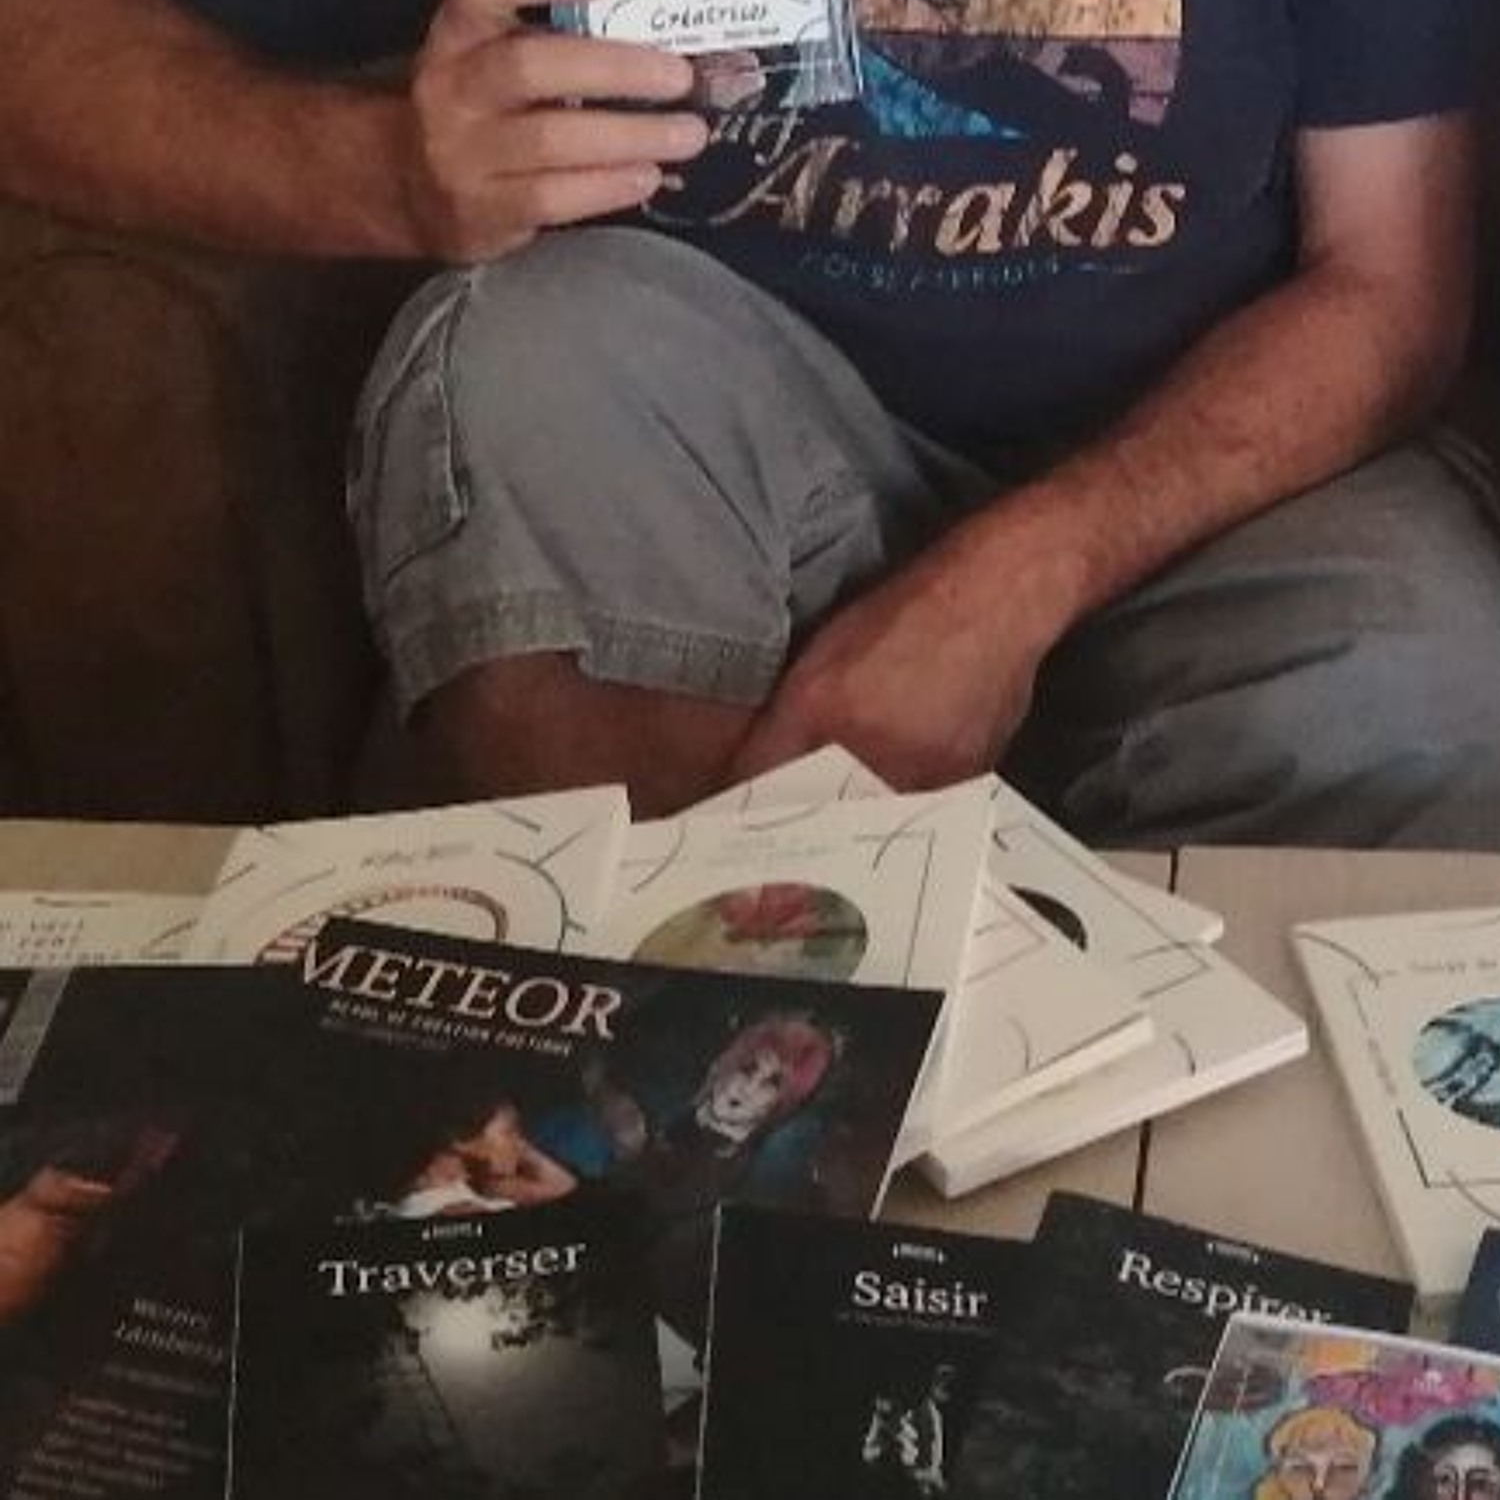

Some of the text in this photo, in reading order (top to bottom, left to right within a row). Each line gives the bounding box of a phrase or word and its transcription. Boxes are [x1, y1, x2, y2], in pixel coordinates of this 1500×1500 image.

[643, 134, 1187, 254] Arrakis
[303, 938, 622, 1041] METEOR
[318, 1243, 587, 1297] Traverser
[853, 1270, 988, 1317] Saisir
